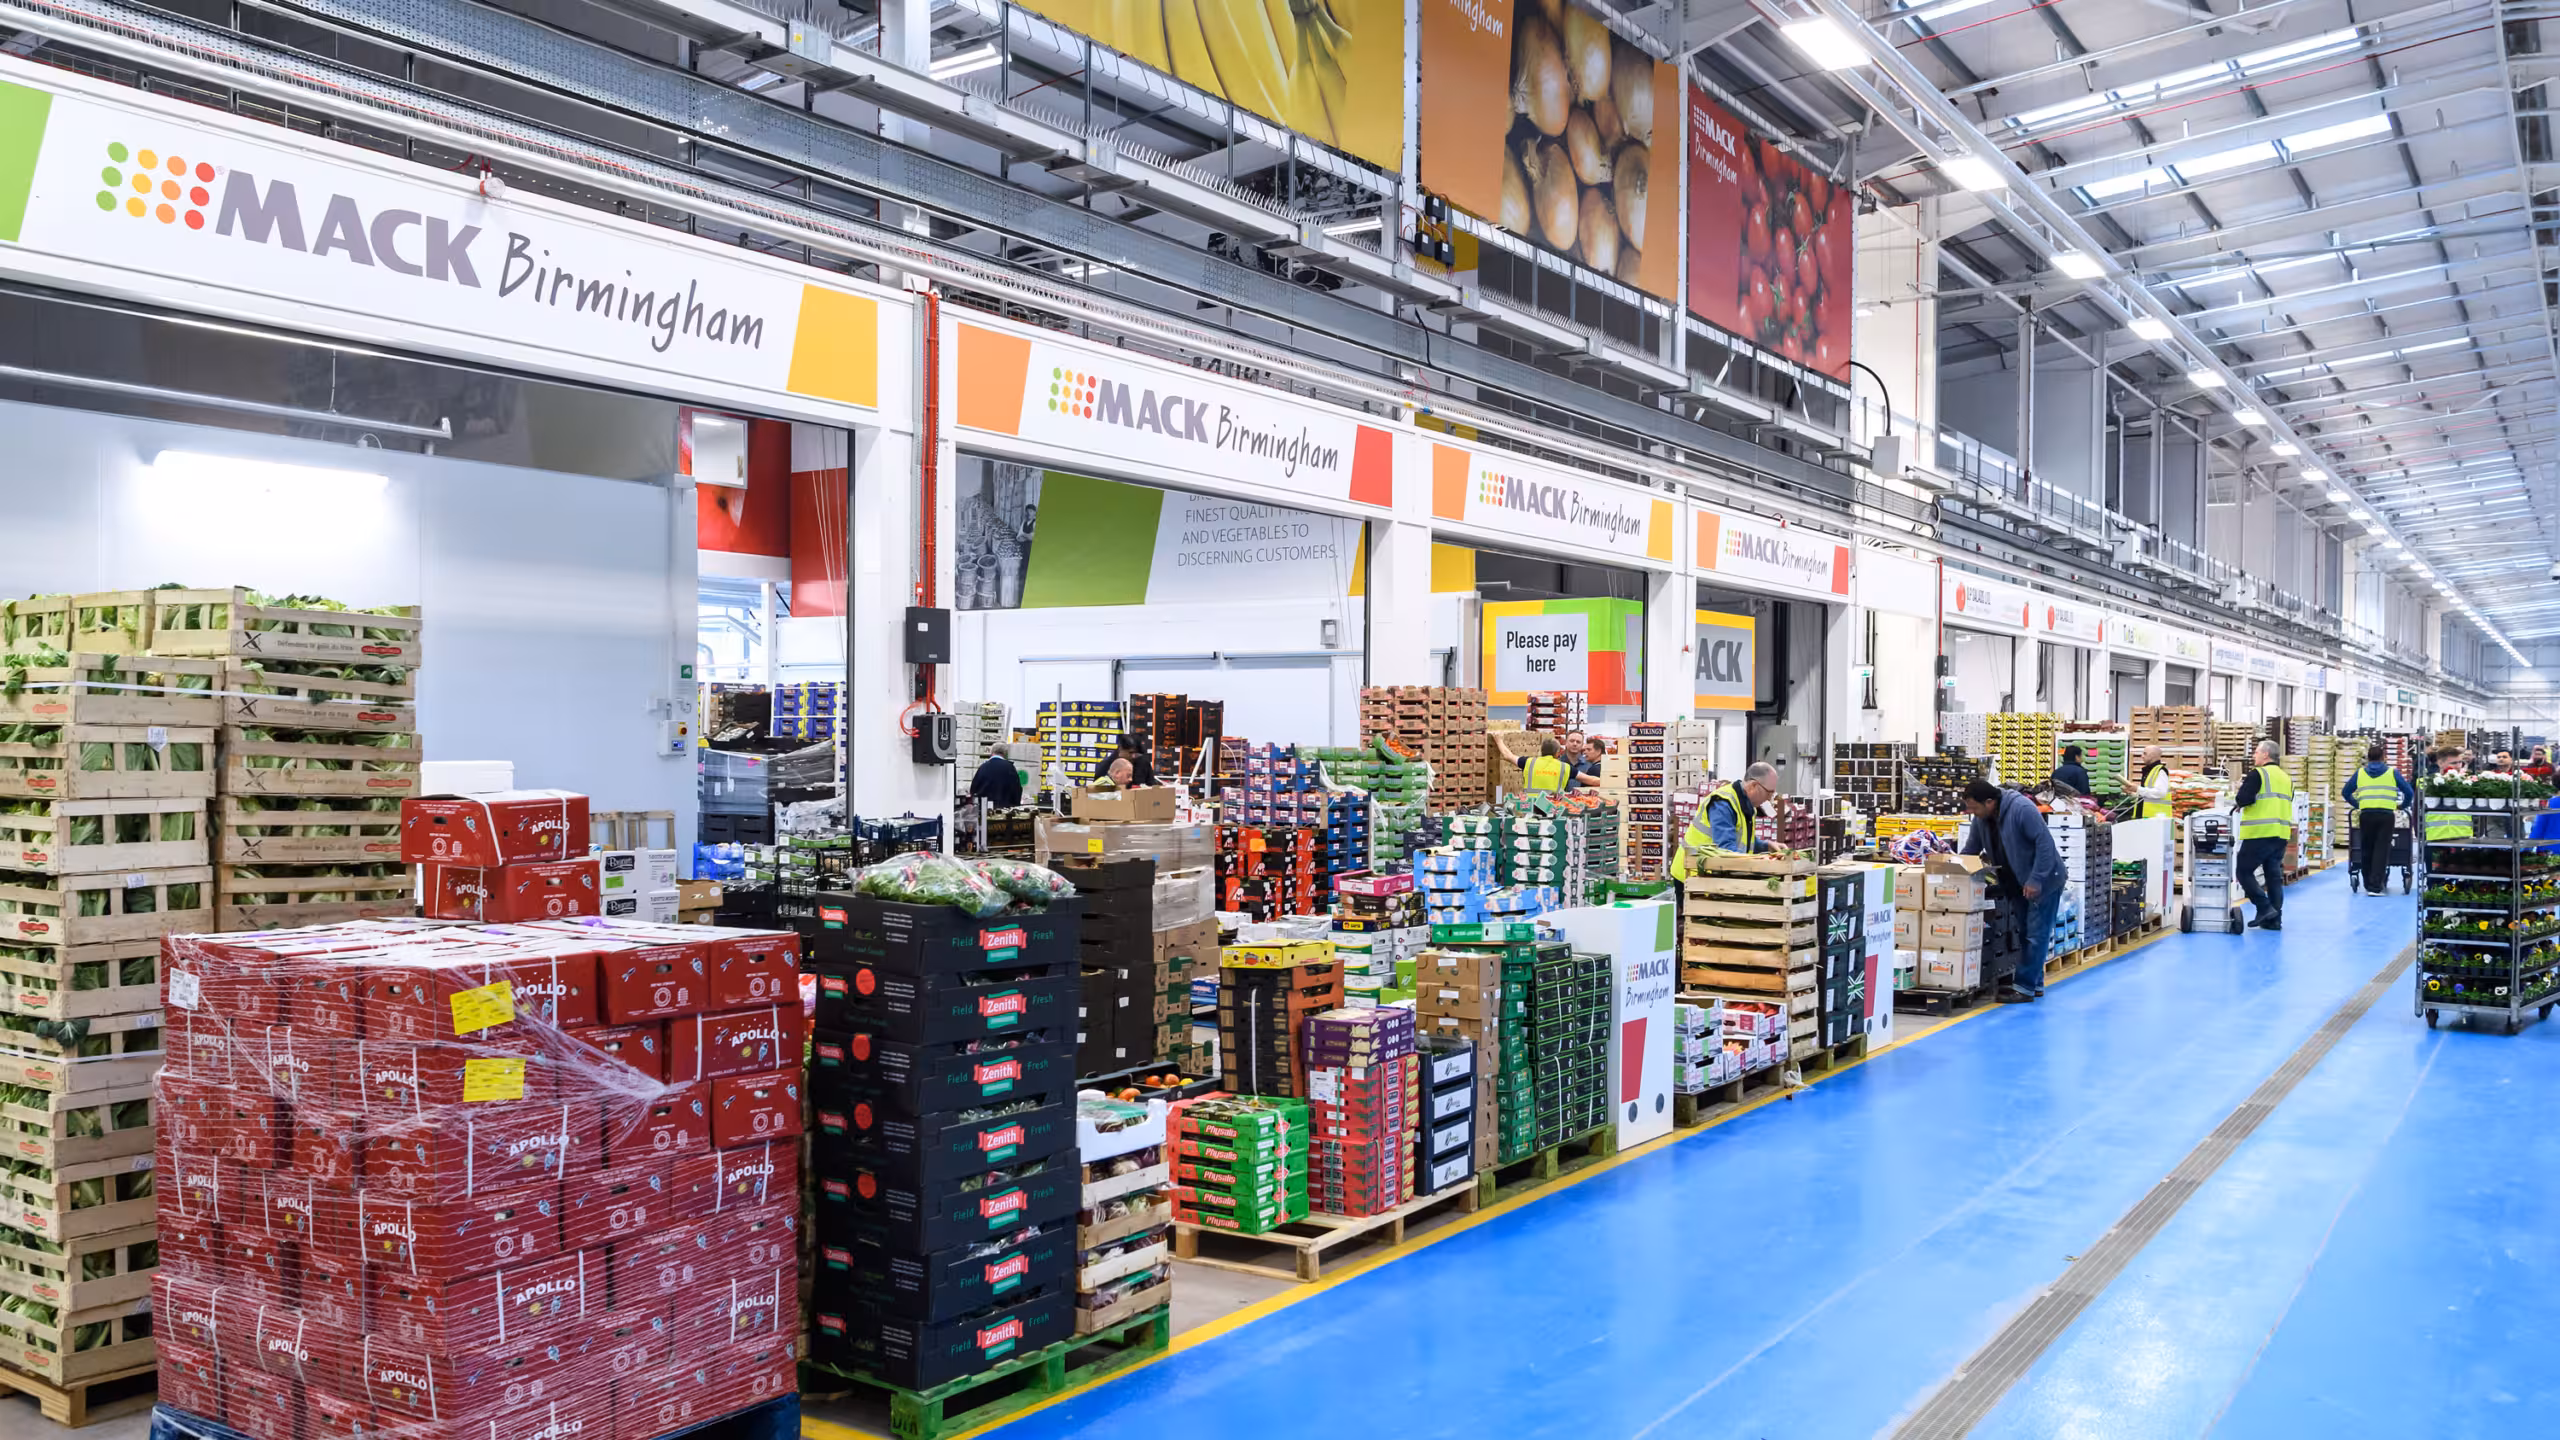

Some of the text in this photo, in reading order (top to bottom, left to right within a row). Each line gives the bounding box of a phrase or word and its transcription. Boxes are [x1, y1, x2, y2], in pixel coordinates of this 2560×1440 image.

[1705, 114, 1736, 157] MACK
[1695, 131, 1737, 185] Birmingham
[214, 167, 765, 354] MACK Birmingham
[1096, 379, 1339, 478] MACK Birmingham
[1185, 507, 1226, 523] FINEST
[1504, 476, 1641, 543] MACK Birmingham
[1181, 523, 1309, 545] AND VEGETABLES TO
[1177, 543, 1338, 567] DISCERNING CUSTOMERS.
[1741, 531, 1828, 582] MACK Birmingham
[1506, 630, 1578, 653] Please pay
[1526, 654, 1556, 673] here
[1638, 744, 1662, 752] VIKINGS
[1639, 761, 1663, 770] VIKINGS
[1637, 778, 1662, 786] VIKINGS
[1638, 795, 1662, 803] VIKINGS
[1639, 812, 1663, 821] VIKINGS
[531, 819, 570, 835] APOLLO
[1641, 846, 1661, 855] IKINGS
[456, 883, 488, 898] APOLLO
[1872, 909, 1892, 924] MACK
[952, 929, 1054, 947] Field Zenith Fresh
[1638, 958, 1669, 981] MACK
[952, 993, 1053, 1016] Field Zenith Fresh
[1626, 982, 1669, 1009] Birmingham
[194, 1035, 225, 1051] APOLLO
[731, 1029, 779, 1047] APOLLO
[273, 1055, 309, 1073] APOLLO
[947, 1059, 1049, 1085] Field Zenith Fresh
[375, 1071, 417, 1087] APOLLO
[952, 1122, 1051, 1153] Field Zenith Fresh
[1206, 1124, 1237, 1138] Physalis
[509, 1134, 570, 1157] APOLLO
[1205, 1147, 1237, 1160] Physalis
[188, 1174, 219, 1192] APOLLO
[727, 1163, 774, 1184] APOLLO
[1204, 1170, 1236, 1184] Physalis
[277, 1197, 311, 1215] APOLLO
[953, 1186, 1054, 1221] Field Zenith Fresh
[1204, 1193, 1236, 1207] Physalis
[1206, 1216, 1239, 1229] Physalis
[374, 1223, 417, 1242] APOLLO
[960, 1274, 980, 1288] Field
[993, 1259, 1021, 1279] Zenith
[516, 1278, 576, 1305] APOLLO
[951, 1312, 1050, 1354] Field Zenith Fresh
[268, 1339, 308, 1361] APOLLO
[381, 1370, 427, 1391] APOLLO
[526, 1420, 582, 1440] POLLO
